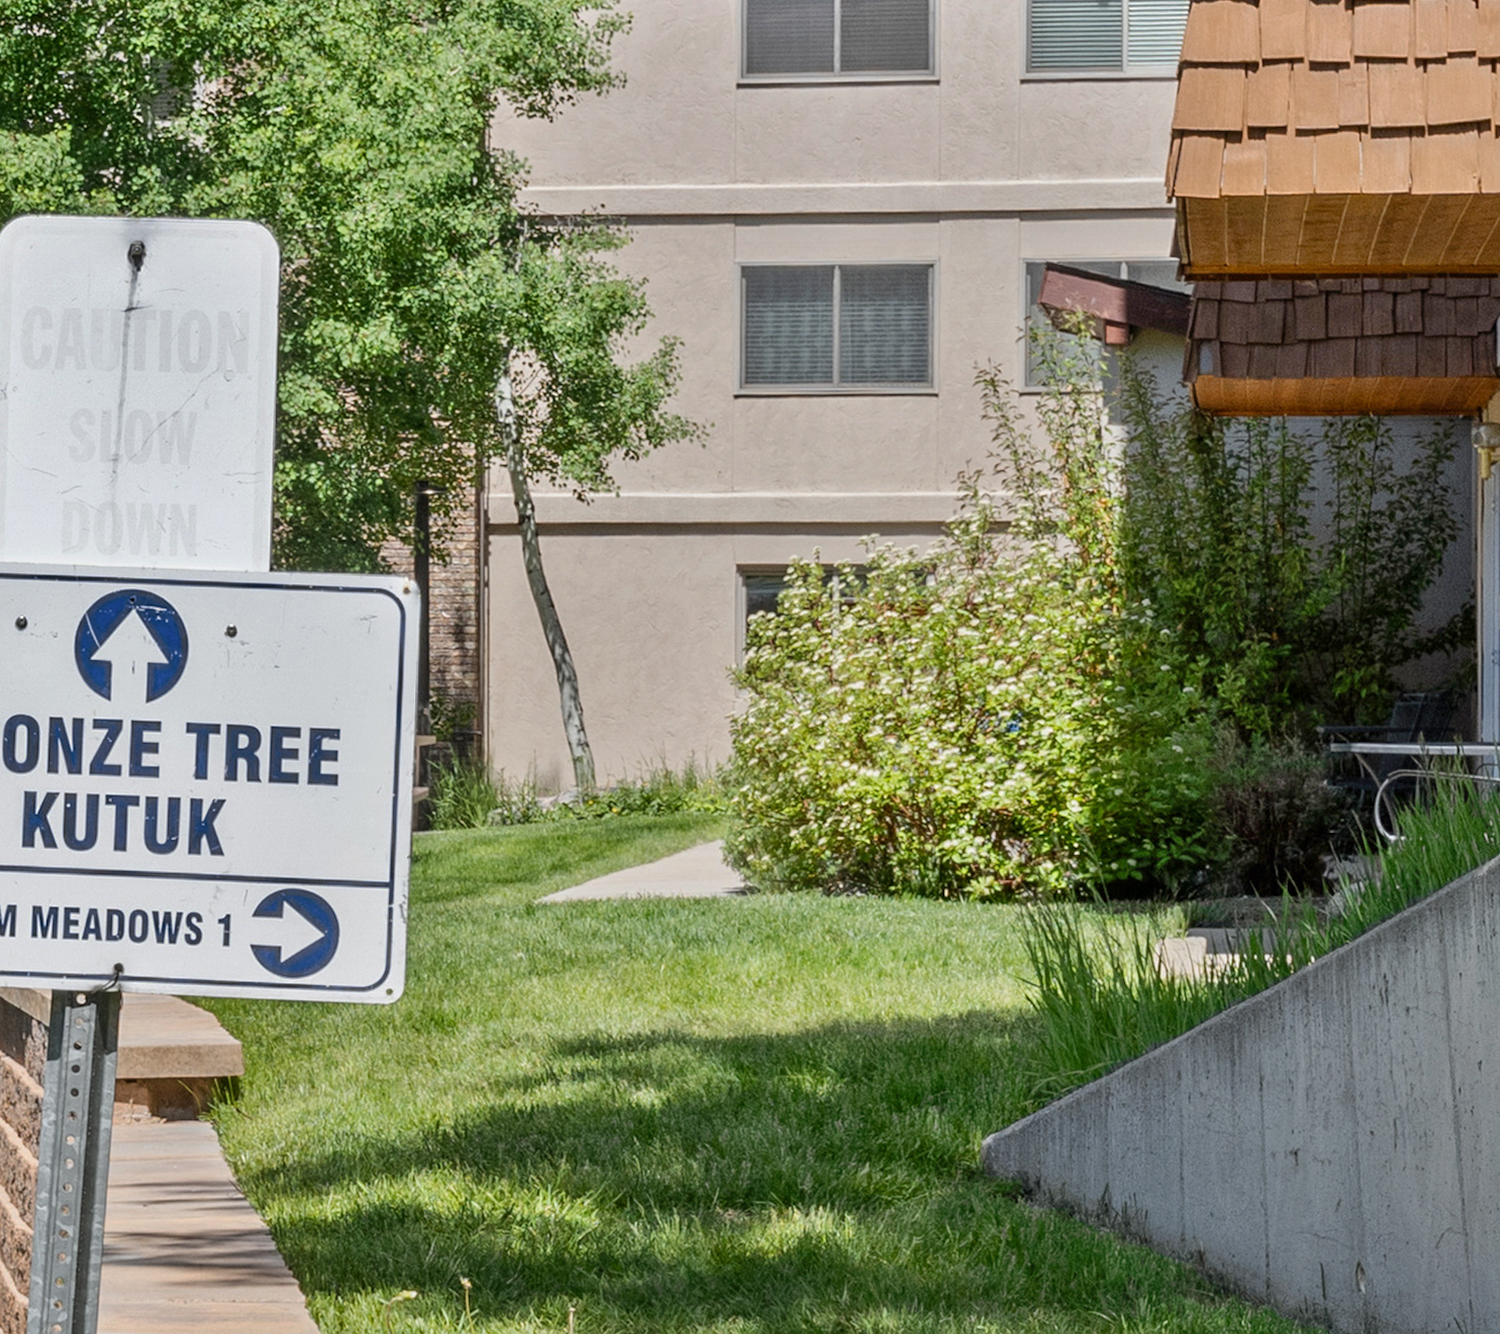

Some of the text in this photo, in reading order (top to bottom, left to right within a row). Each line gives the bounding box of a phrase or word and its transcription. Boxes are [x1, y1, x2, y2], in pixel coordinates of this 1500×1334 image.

[20, 305, 250, 374] CAUTION
[67, 407, 198, 465] SLOW
[61, 500, 198, 557] DOWN
[185, 721, 341, 787] TREE
[21, 790, 227, 857] KUTUK
[30, 905, 204, 946] MEADOWS
[217, 913, 232, 947] 1
